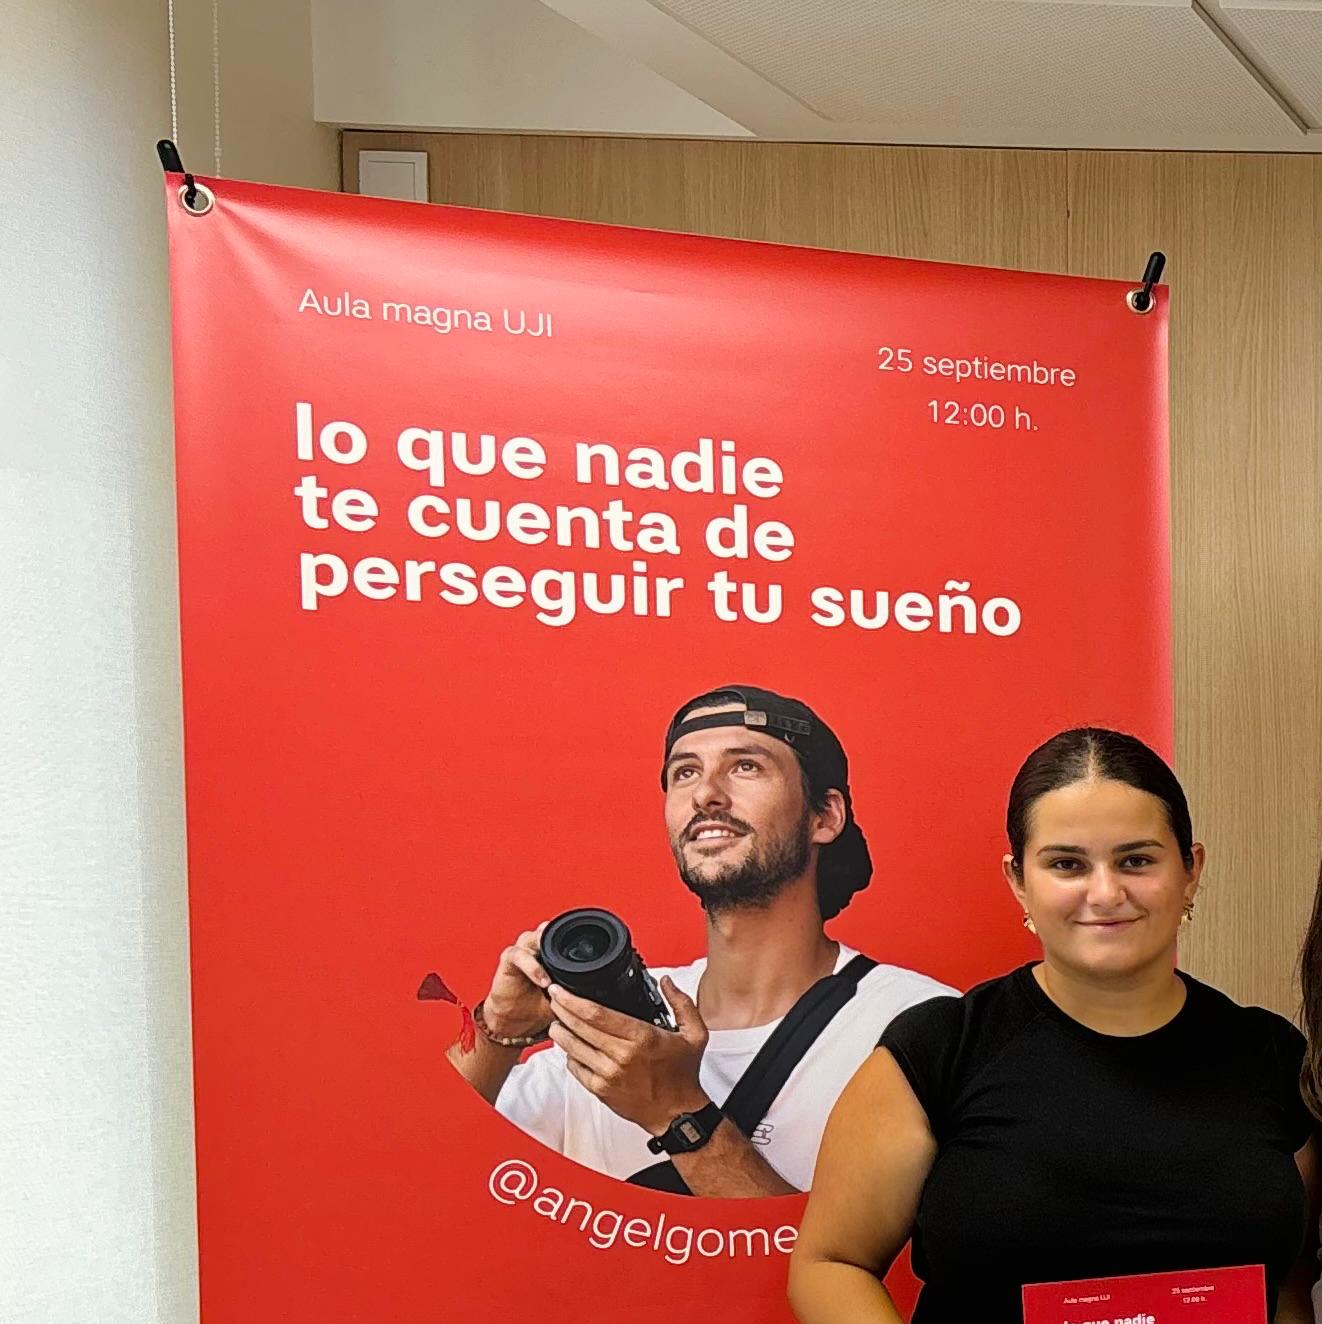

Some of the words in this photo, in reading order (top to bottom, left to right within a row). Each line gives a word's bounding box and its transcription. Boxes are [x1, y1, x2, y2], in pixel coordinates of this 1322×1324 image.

[299, 289, 372, 320] Aula
[383, 303, 492, 333] magna
[504, 309, 552, 337] UJI
[878, 347, 912, 372] 25
[923, 356, 1077, 387] septiembre
[296, 402, 367, 464] lo
[397, 428, 546, 487] que
[576, 438, 783, 498] nadie
[928, 400, 1006, 428] 12:00
[1013, 404, 1039, 431] h.
[294, 476, 378, 531] te
[408, 495, 680, 554] cuenta
[705, 504, 794, 561] de
[300, 553, 684, 626] perseguir
[707, 571, 782, 623] tu
[811, 580, 1021, 636] sueño
[487, 1157, 799, 1266] @angelgome
